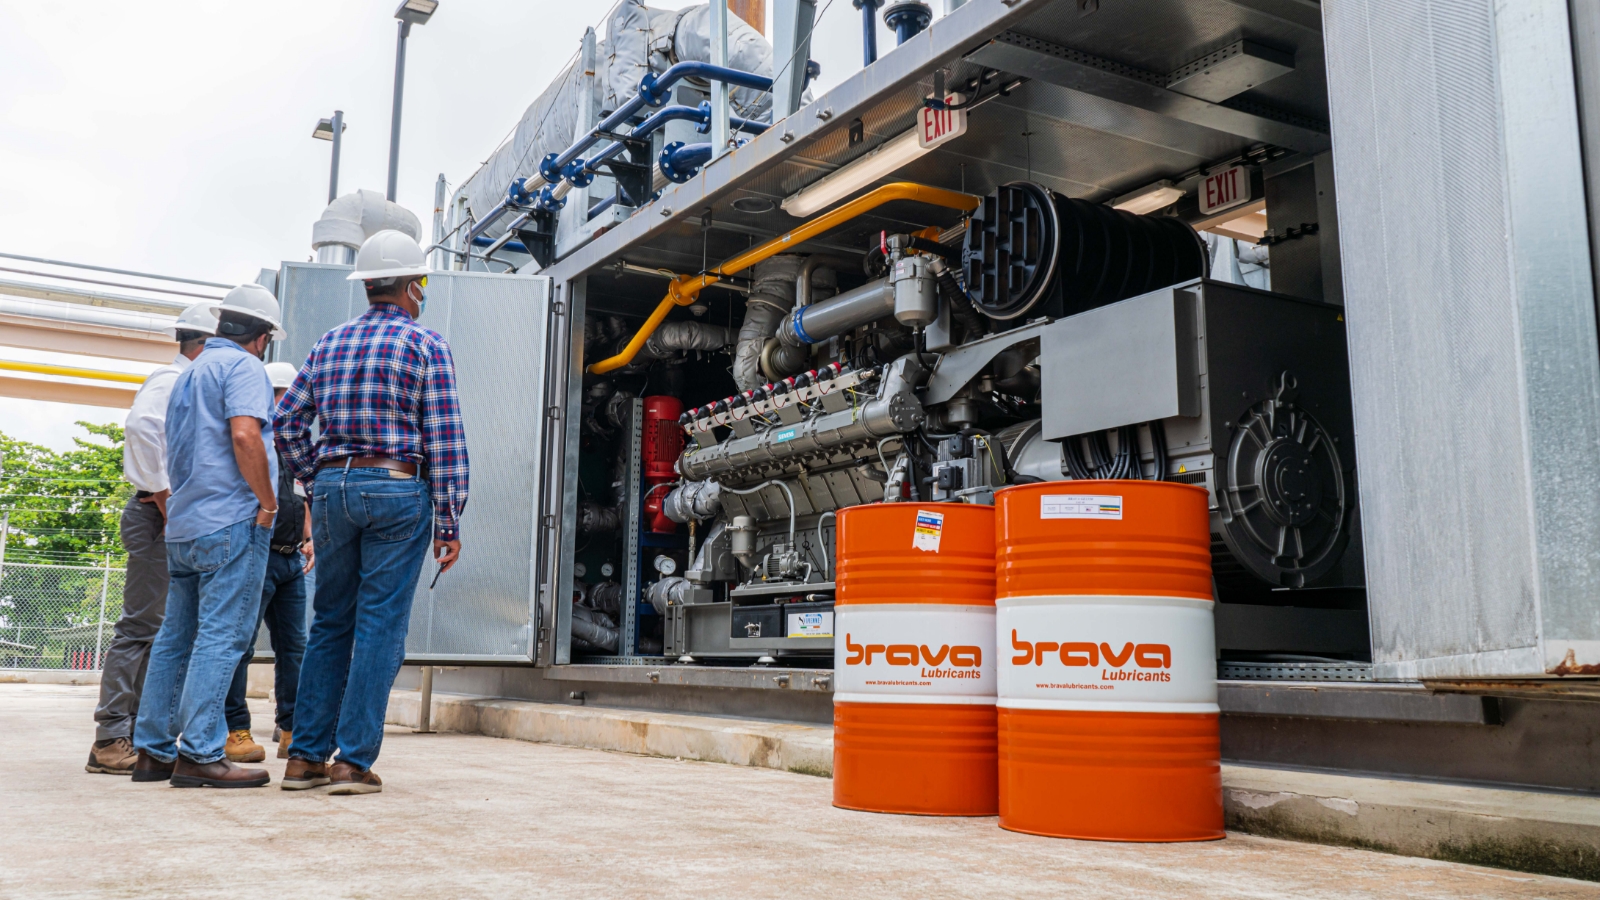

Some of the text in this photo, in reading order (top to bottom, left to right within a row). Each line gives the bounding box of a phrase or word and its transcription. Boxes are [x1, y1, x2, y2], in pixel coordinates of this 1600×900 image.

[924, 96, 952, 143] EXIT
[1206, 168, 1238, 209] EXIT
[846, 633, 982, 667] brava
[1011, 628, 1172, 669] brava
[921, 667, 981, 679] Lubricants
[1102, 669, 1171, 682] Lubricants
